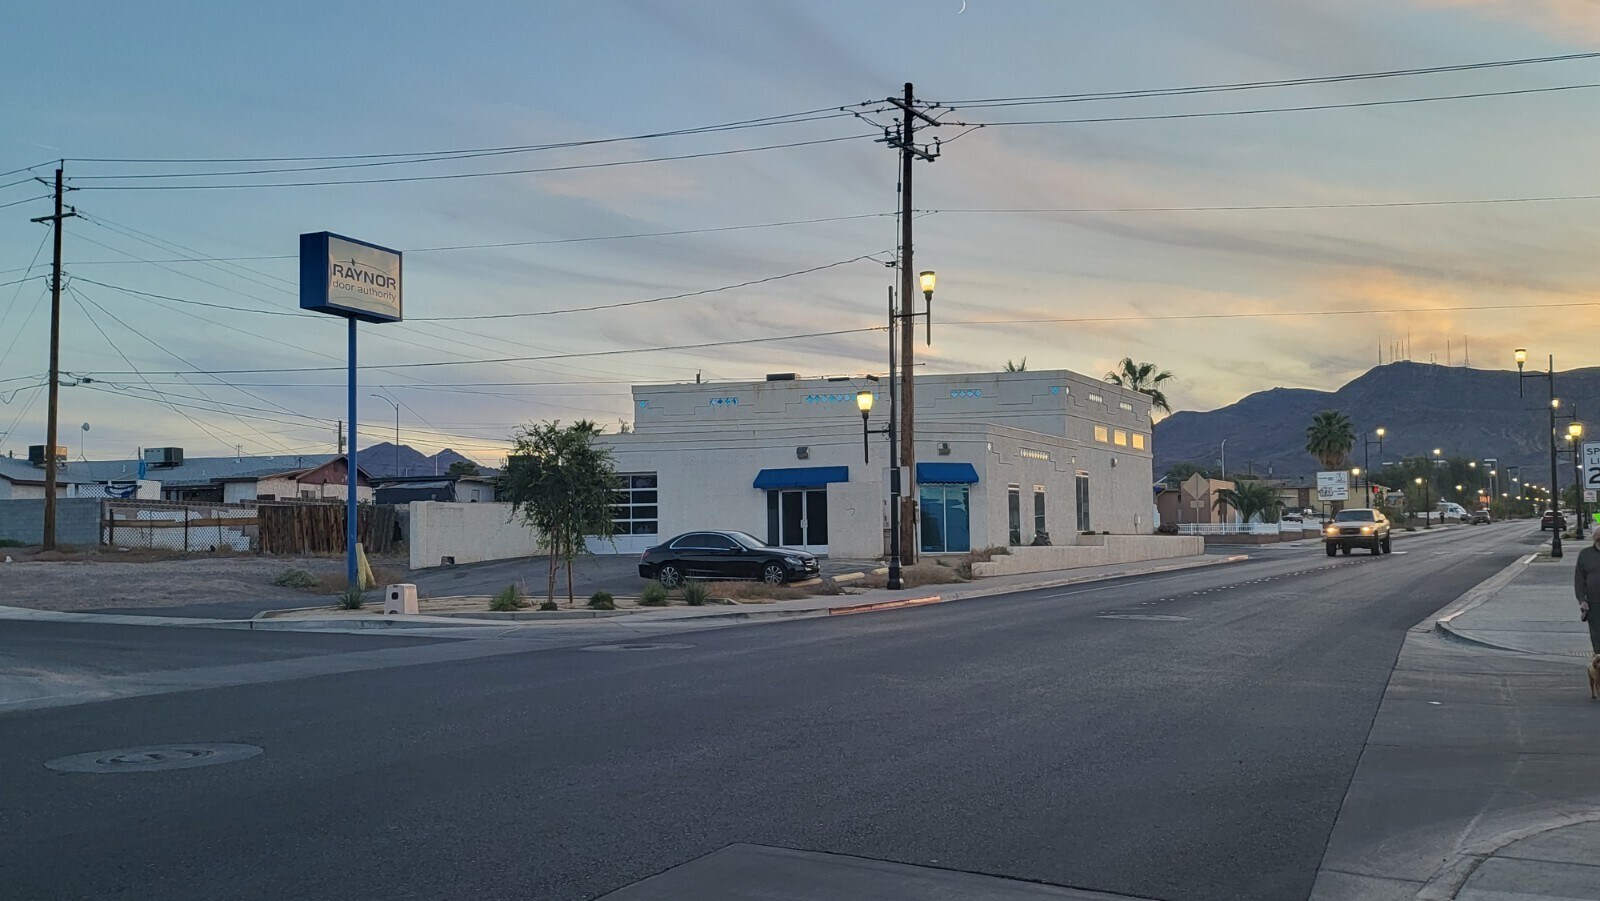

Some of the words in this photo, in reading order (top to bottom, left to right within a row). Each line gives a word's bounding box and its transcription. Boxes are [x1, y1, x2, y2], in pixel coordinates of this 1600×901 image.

[333, 264, 396, 290] RAYNOR
[333, 280, 355, 291] door
[358, 286, 396, 302] authority
